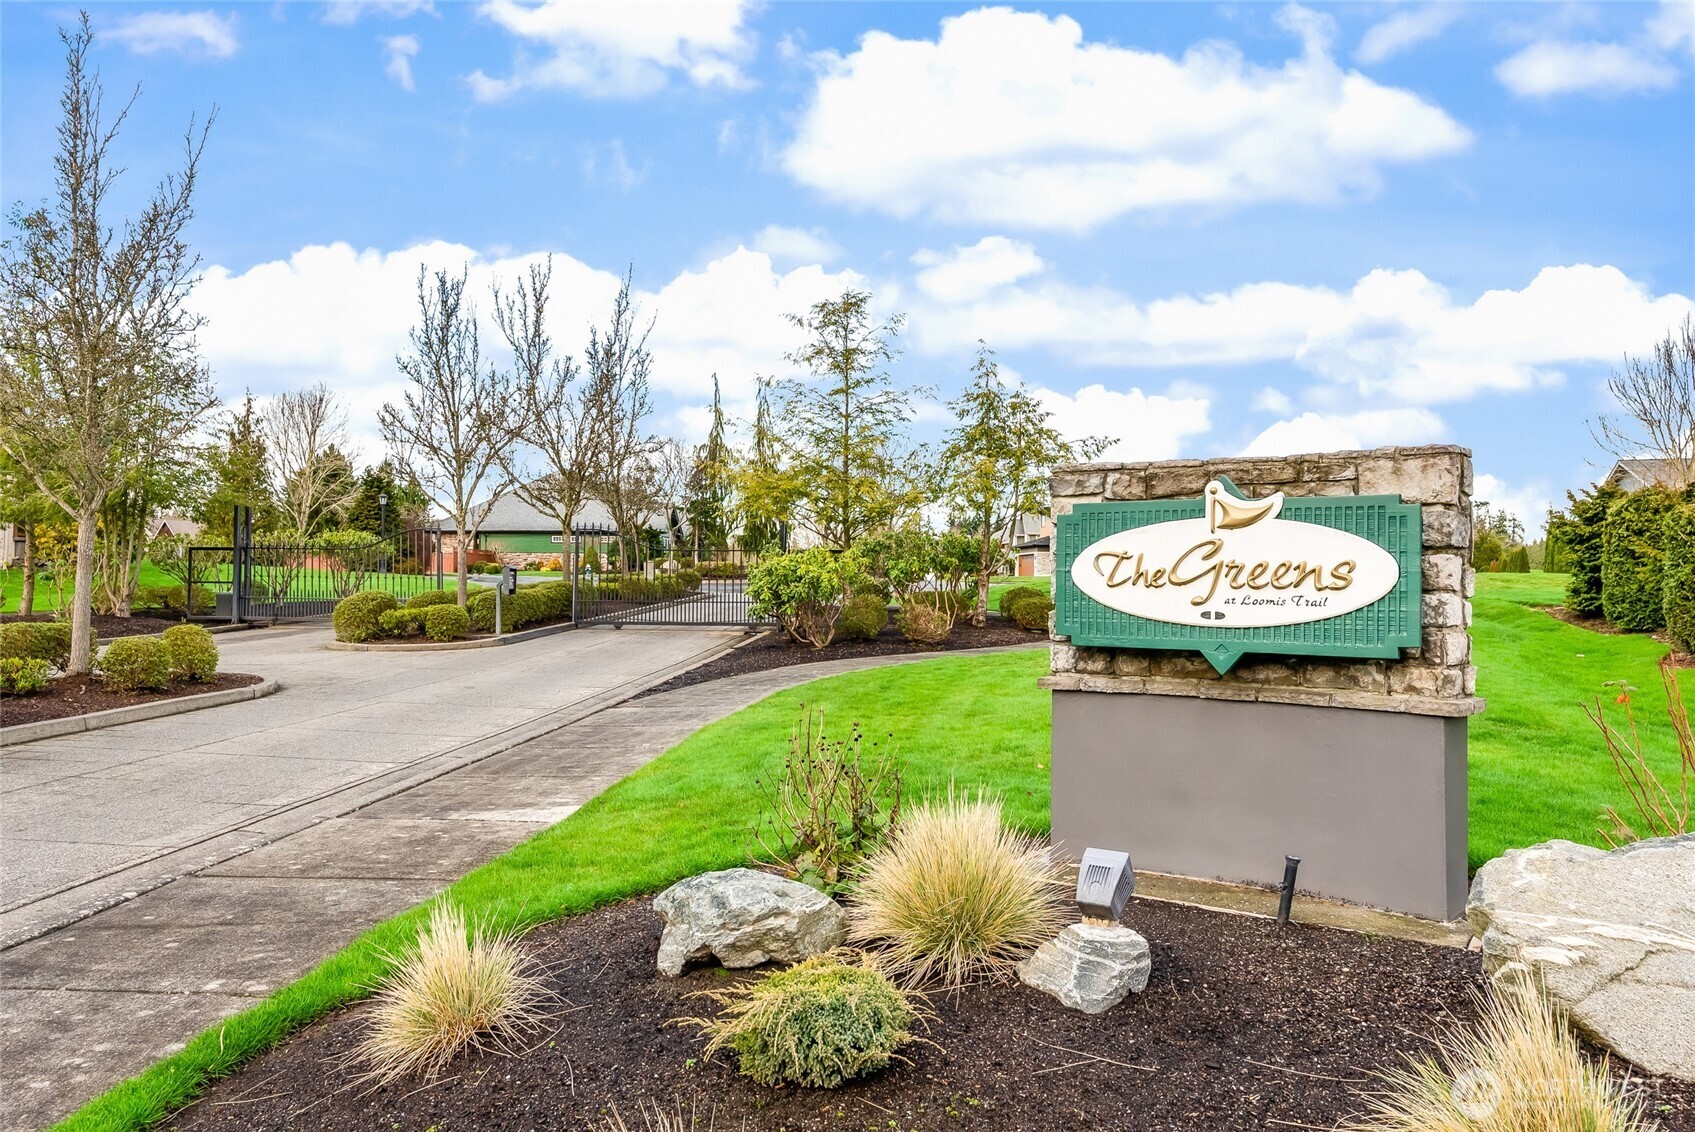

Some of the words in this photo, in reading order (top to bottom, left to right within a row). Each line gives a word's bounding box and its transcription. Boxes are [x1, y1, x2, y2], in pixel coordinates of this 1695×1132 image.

[1092, 550, 1167, 589] The
[1167, 538, 1357, 607] Greens
[1224, 597, 1236, 605] at
[1240, 594, 1287, 606] Loomis
[1291, 595, 1328, 607] Trail
